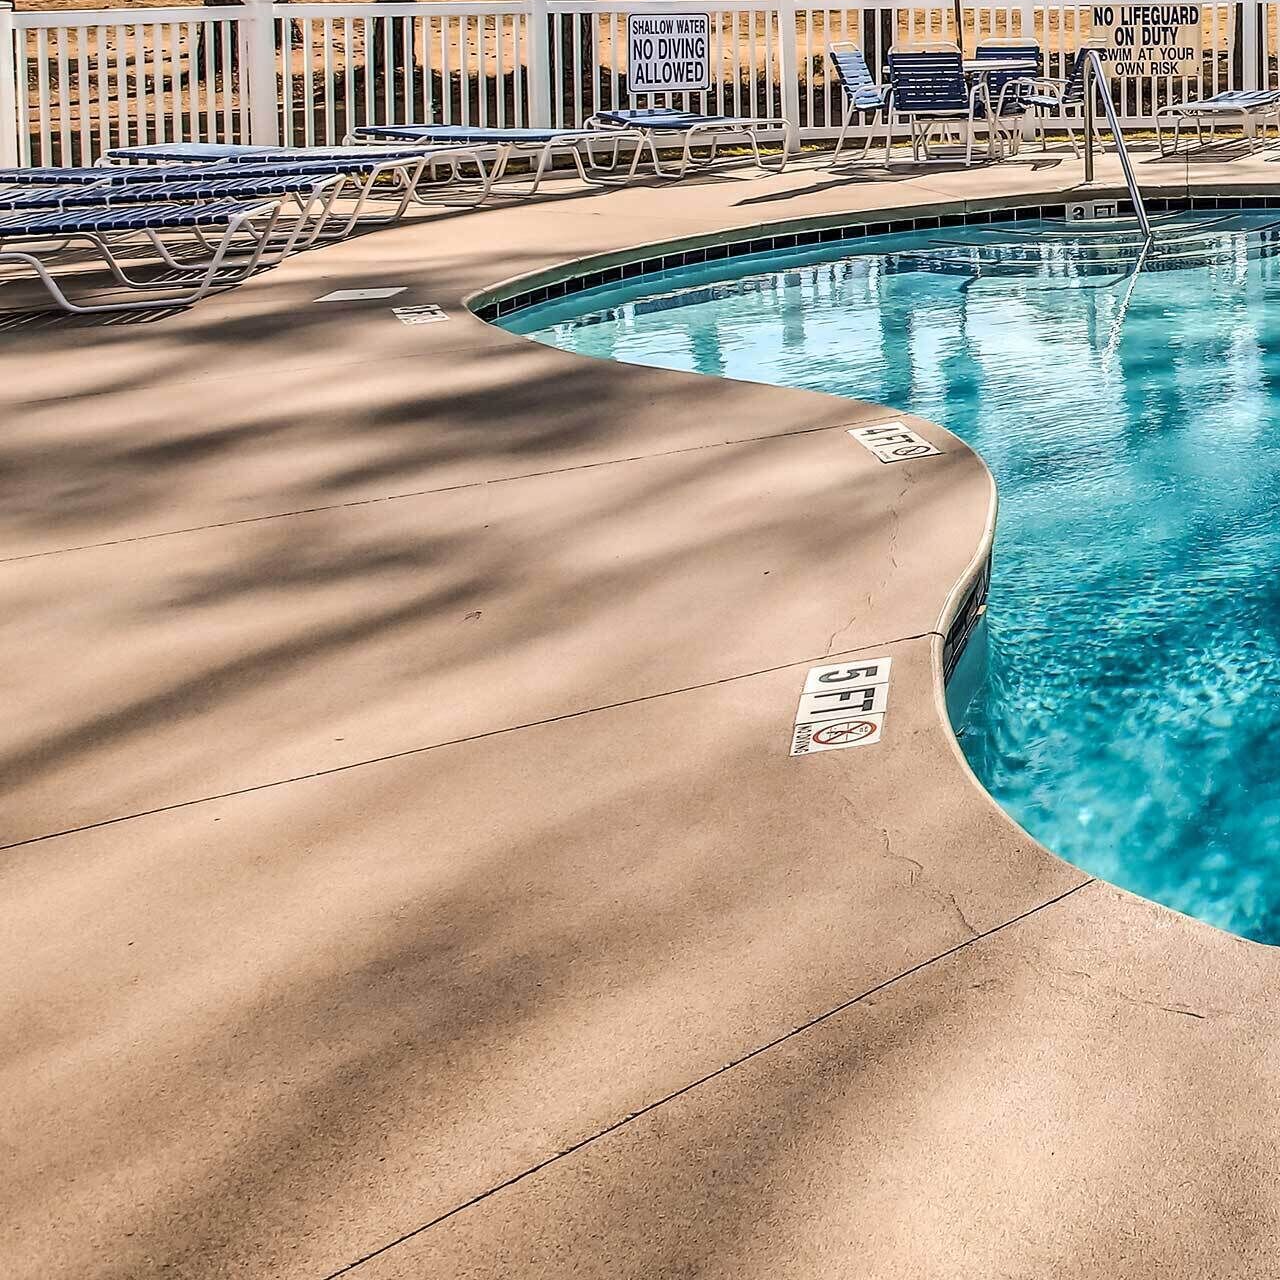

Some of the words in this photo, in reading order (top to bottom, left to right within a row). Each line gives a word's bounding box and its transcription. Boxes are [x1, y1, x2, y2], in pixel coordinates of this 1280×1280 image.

[1093, 6, 1114, 26] NO
[1120, 5, 1199, 25] LIFEGUARD
[632, 20, 673, 35] SHALLOW
[676, 19, 705, 34] WATER
[1114, 26, 1134, 46] ON
[1142, 26, 1179, 45] DUTY
[633, 38, 654, 60] NO
[658, 37, 705, 59] DIVING
[1101, 47, 1132, 61] SWIM
[1138, 47, 1154, 61] AT
[1160, 47, 1194, 61] YOUR
[635, 61, 704, 84] ALLOWED
[1115, 61, 1144, 75] OWN
[1150, 61, 1179, 75] RISK
[860, 427, 900, 436] 4
[867, 434, 915, 448] FT
[818, 665, 879, 683] 5
[810, 687, 876, 715] FT
